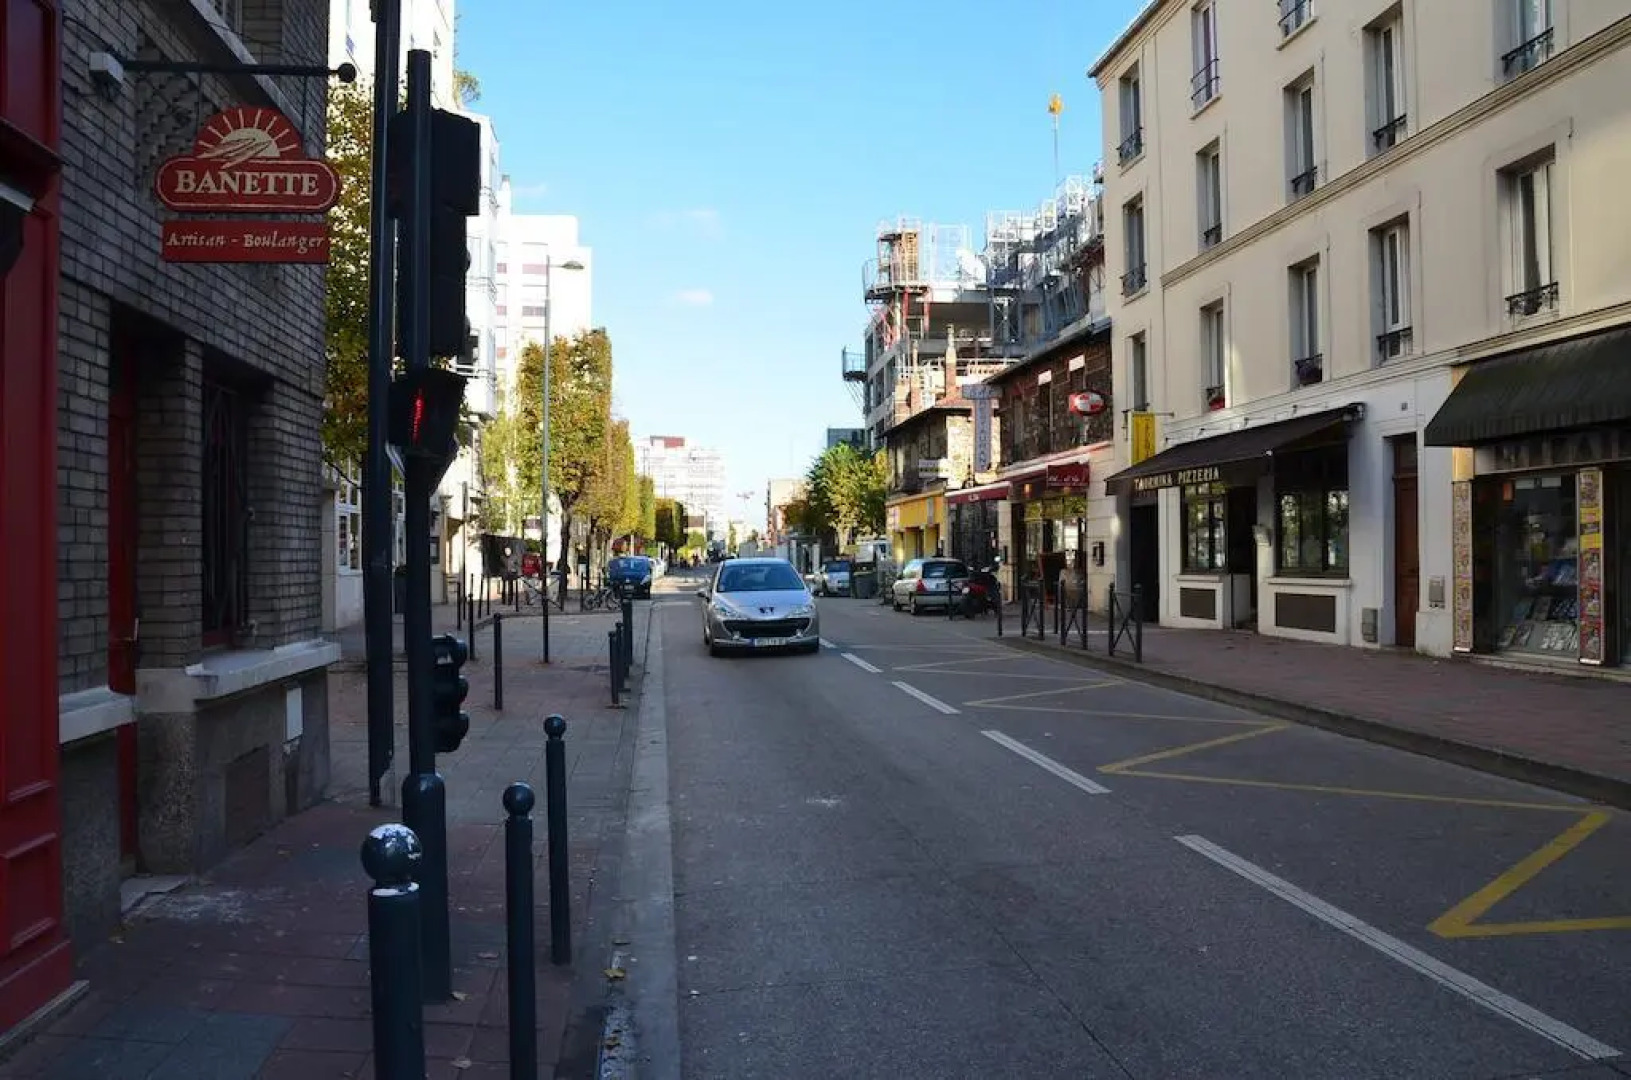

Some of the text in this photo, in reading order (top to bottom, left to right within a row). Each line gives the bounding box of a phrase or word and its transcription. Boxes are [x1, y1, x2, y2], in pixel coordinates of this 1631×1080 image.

[175, 170, 319, 196] BANETTE
[166, 231, 226, 246] Artisan
[243, 230, 324, 254] Boulanger
[1178, 466, 1220, 484] PIZZERIA
